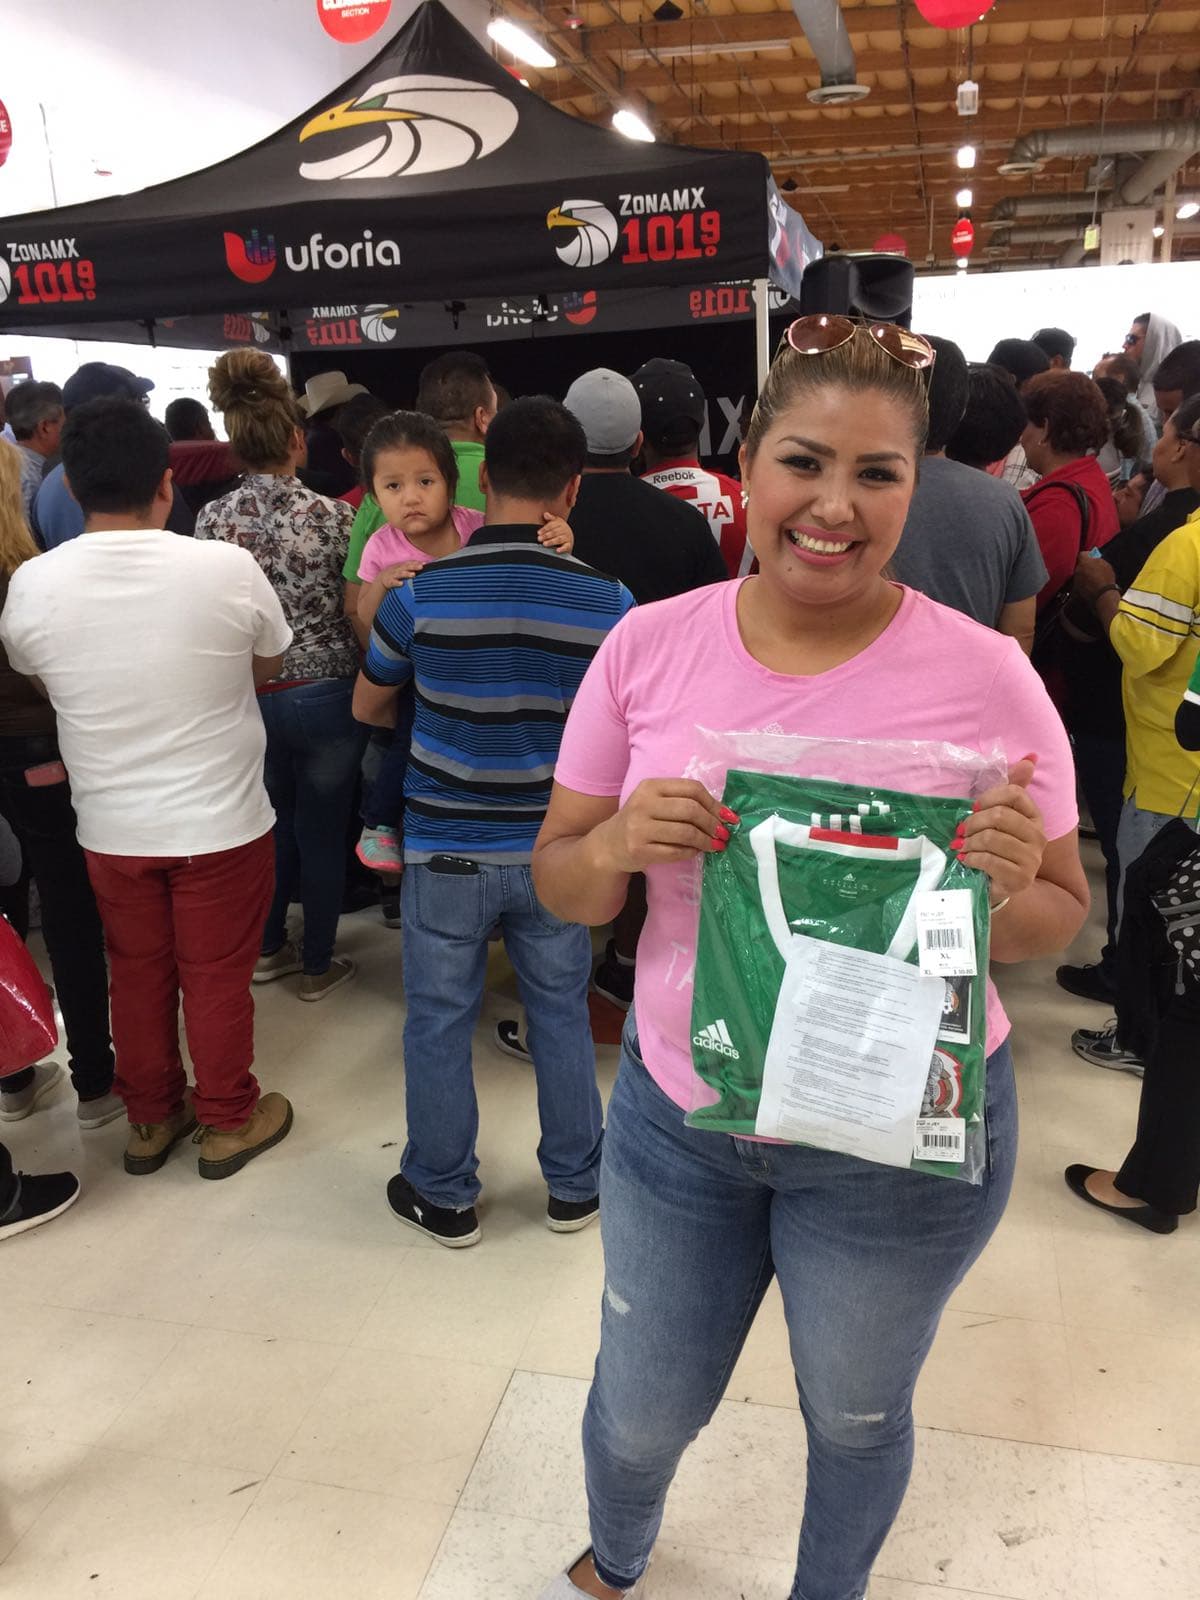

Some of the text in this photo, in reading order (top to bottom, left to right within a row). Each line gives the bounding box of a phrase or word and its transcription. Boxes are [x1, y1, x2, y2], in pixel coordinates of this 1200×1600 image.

[341, 8, 369, 18] SECTION
[619, 187, 706, 216] ZONAMX
[6, 238, 80, 262] ZONAMX
[285, 229, 401, 272] uforia
[653, 471, 696, 485] Reebok
[692, 1036, 740, 1060] adidas
